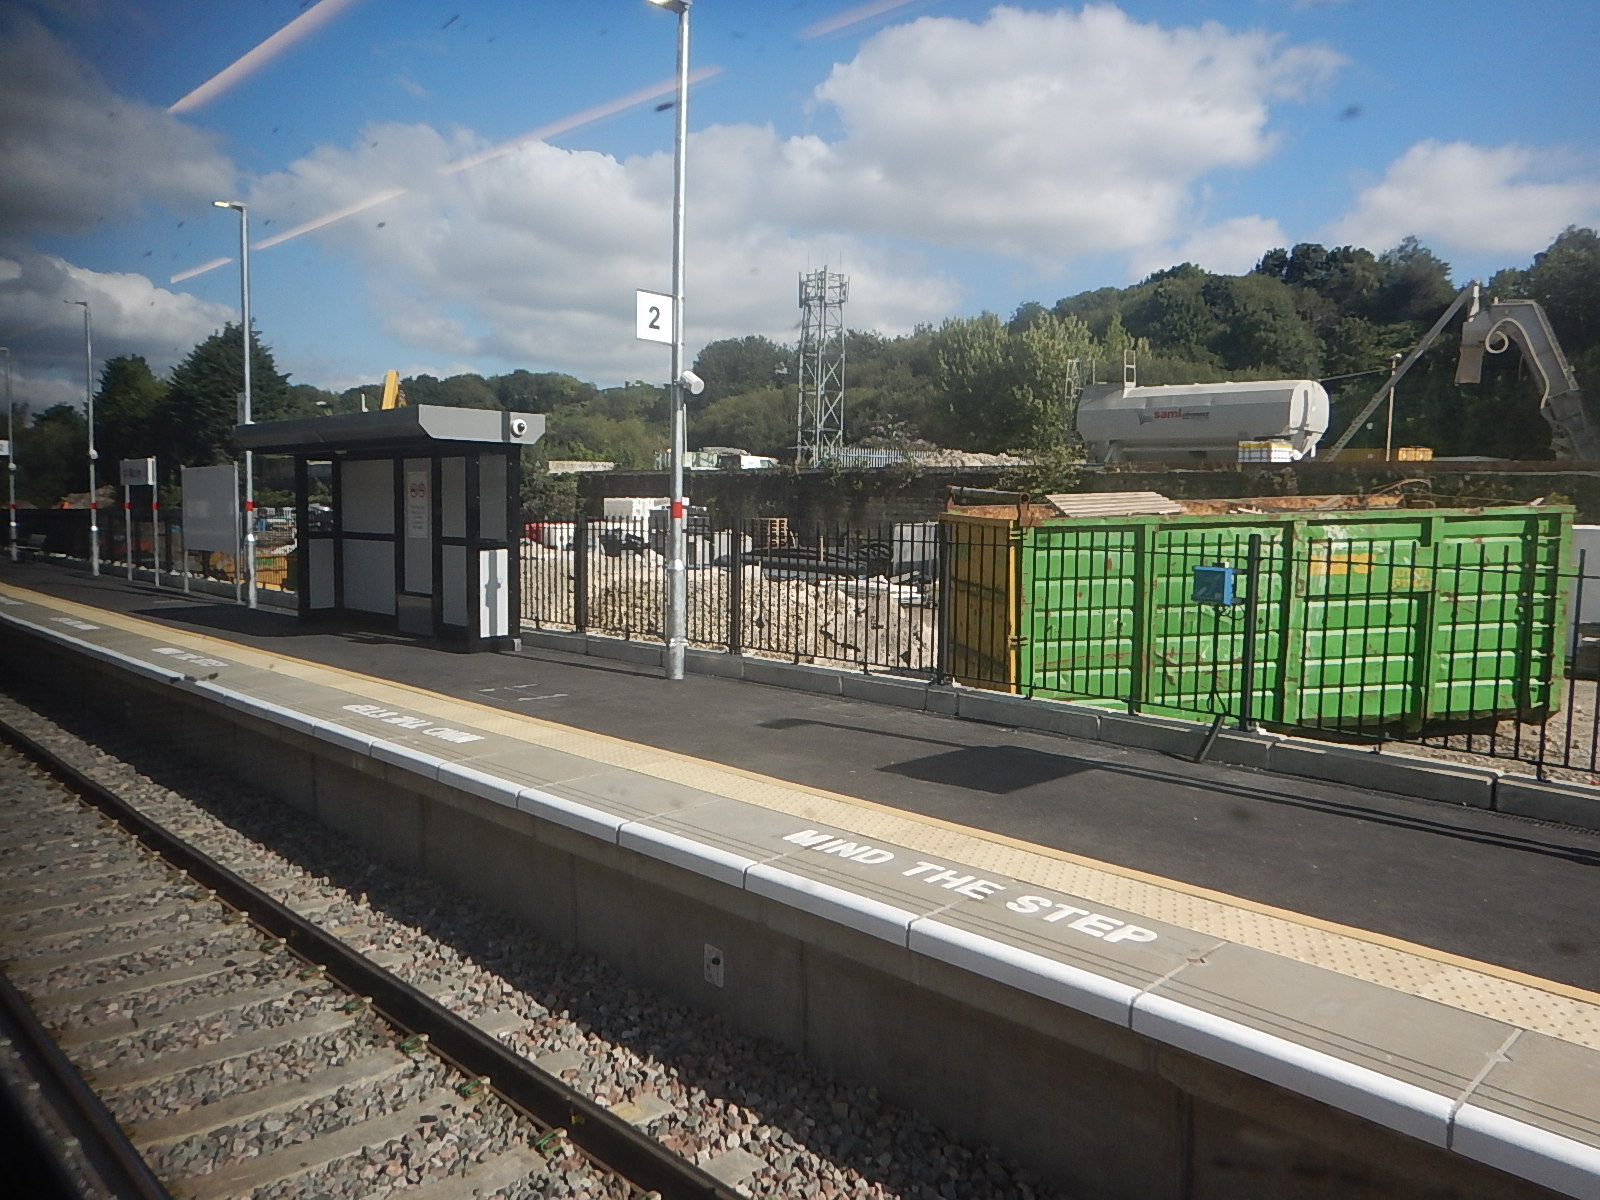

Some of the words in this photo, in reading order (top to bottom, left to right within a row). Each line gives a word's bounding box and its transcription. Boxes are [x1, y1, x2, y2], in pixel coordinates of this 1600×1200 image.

[648, 305, 661, 330] 2
[782, 828, 896, 866] MIND
[902, 860, 1006, 901] THE
[1004, 894, 1159, 944] STEP
